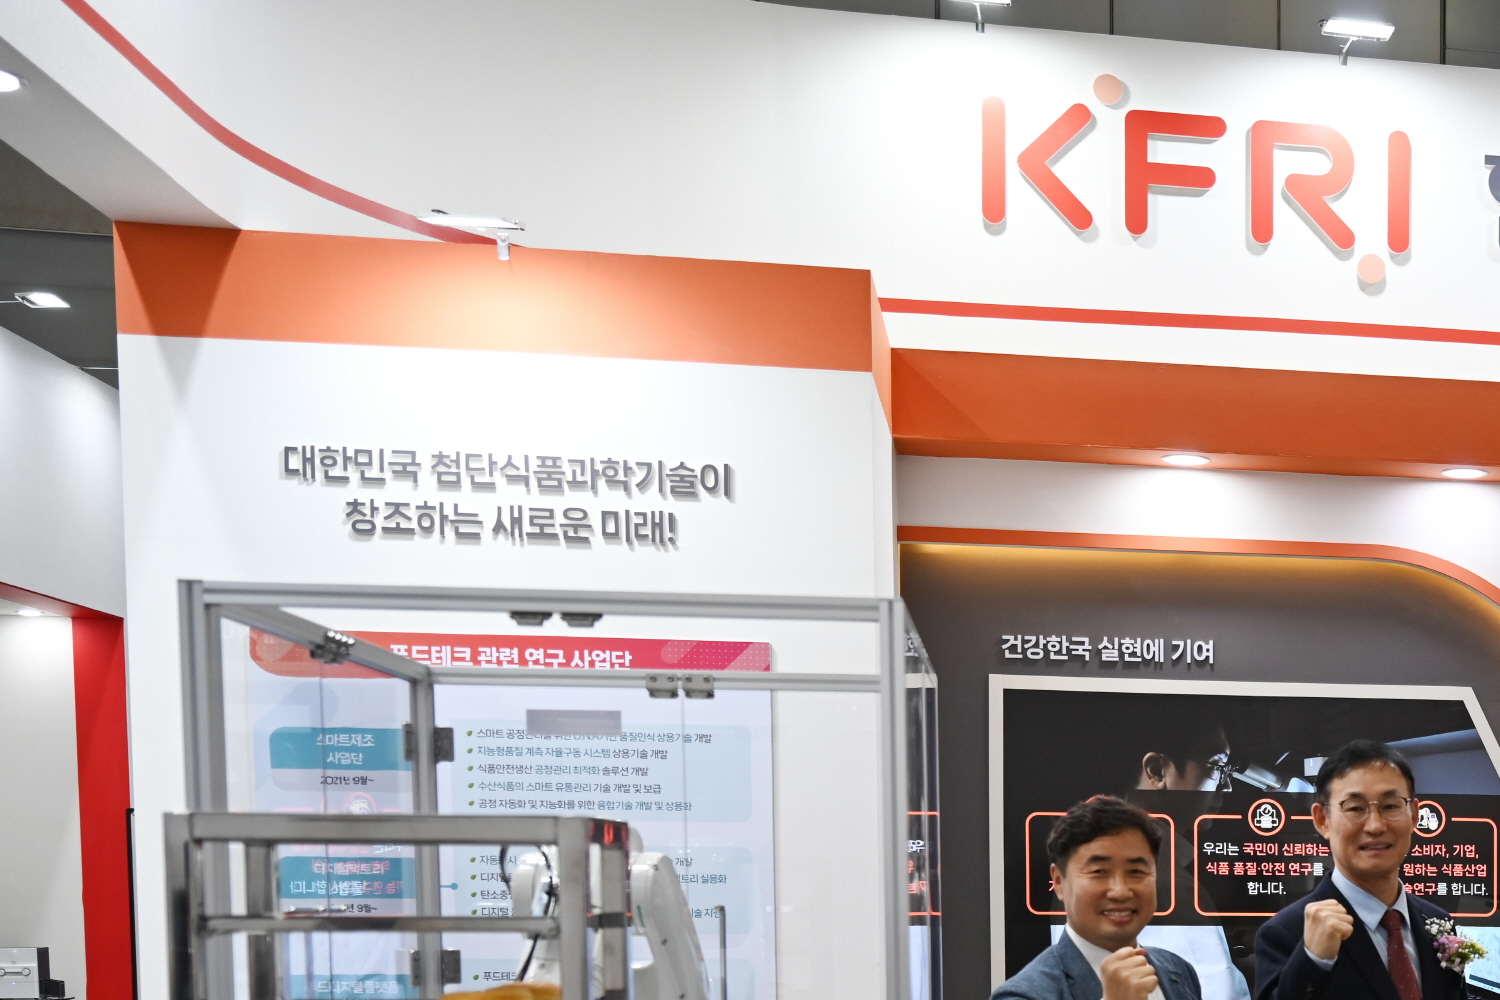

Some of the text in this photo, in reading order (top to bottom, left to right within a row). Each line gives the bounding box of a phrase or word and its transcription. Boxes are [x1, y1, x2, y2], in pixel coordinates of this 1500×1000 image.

[981, 80, 1411, 275] KFRI
[283, 444, 732, 497] 대한민국 첨단식품과학기술이
[345, 498, 678, 544] 창조하는 새로운 미래!
[1001, 635, 1214, 664] 건강한국 실현에 기여
[477, 647, 519, 668] 관련
[524, 648, 566, 669] 연구
[570, 650, 632, 670] 사업단
[694, 733, 712, 744] 개발
[583, 748, 611, 759] 시스템
[612, 749, 648, 759] 상용기술
[650, 749, 668, 760] 개발
[477, 764, 533, 775] 식품안전생산
[534, 765, 571, 775] 공정관리
[601, 766, 629, 777] 솔루션
[630, 766, 649, 777] 개발
[478, 781, 524, 792] 수산식품의
[526, 782, 553, 792] 스마트
[593, 783, 611, 793] 기술
[613, 783, 631, 794] 개발
[633, 784, 642, 794] 및
[643, 784, 662, 794] 보급
[479, 799, 497, 809] 공정
[498, 799, 527, 810] 자동화
[528, 800, 538, 810] 및
[577, 800, 595, 810] 위한
[634, 801, 652, 811] 개발
[1203, 842, 1330, 857] 우리는 국민이 신뢰하는
[1411, 844, 1479, 860] 소비자, 기업,
[1205, 861, 1325, 877] 식품 품질·안전 연구를
[1402, 863, 1487, 878] 원하는 식품산업
[480, 890, 512, 900] 탄소중
[1247, 881, 1287, 896] 합니다.
[1403, 882, 1489, 896] 술연구를 합니다.
